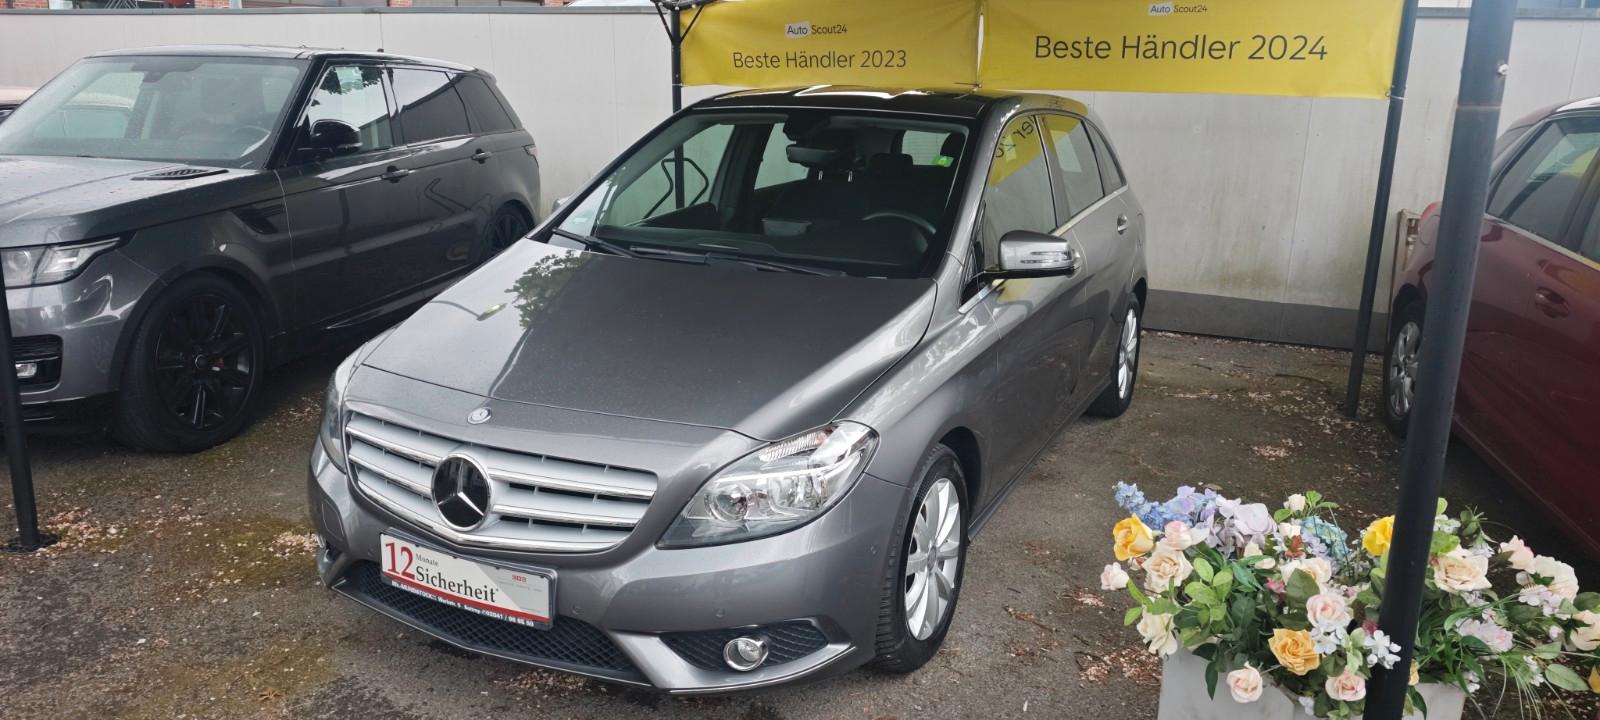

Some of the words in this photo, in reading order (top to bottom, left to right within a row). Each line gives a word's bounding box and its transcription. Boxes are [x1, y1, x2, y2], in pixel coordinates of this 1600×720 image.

[1150, 4, 1171, 14] Auto
[1173, 4, 1208, 14] Scout24
[787, 25, 808, 35] Auto
[811, 24, 848, 35] Scout24
[1035, 35, 1111, 60] Beste
[1121, 34, 1240, 61] Händler
[1248, 34, 1328, 61] 2024
[733, 51, 781, 69] Beste
[785, 50, 856, 69] Händler
[860, 49, 907, 69] 2023
[385, 542, 415, 580] 12
[416, 553, 439, 567] Monate
